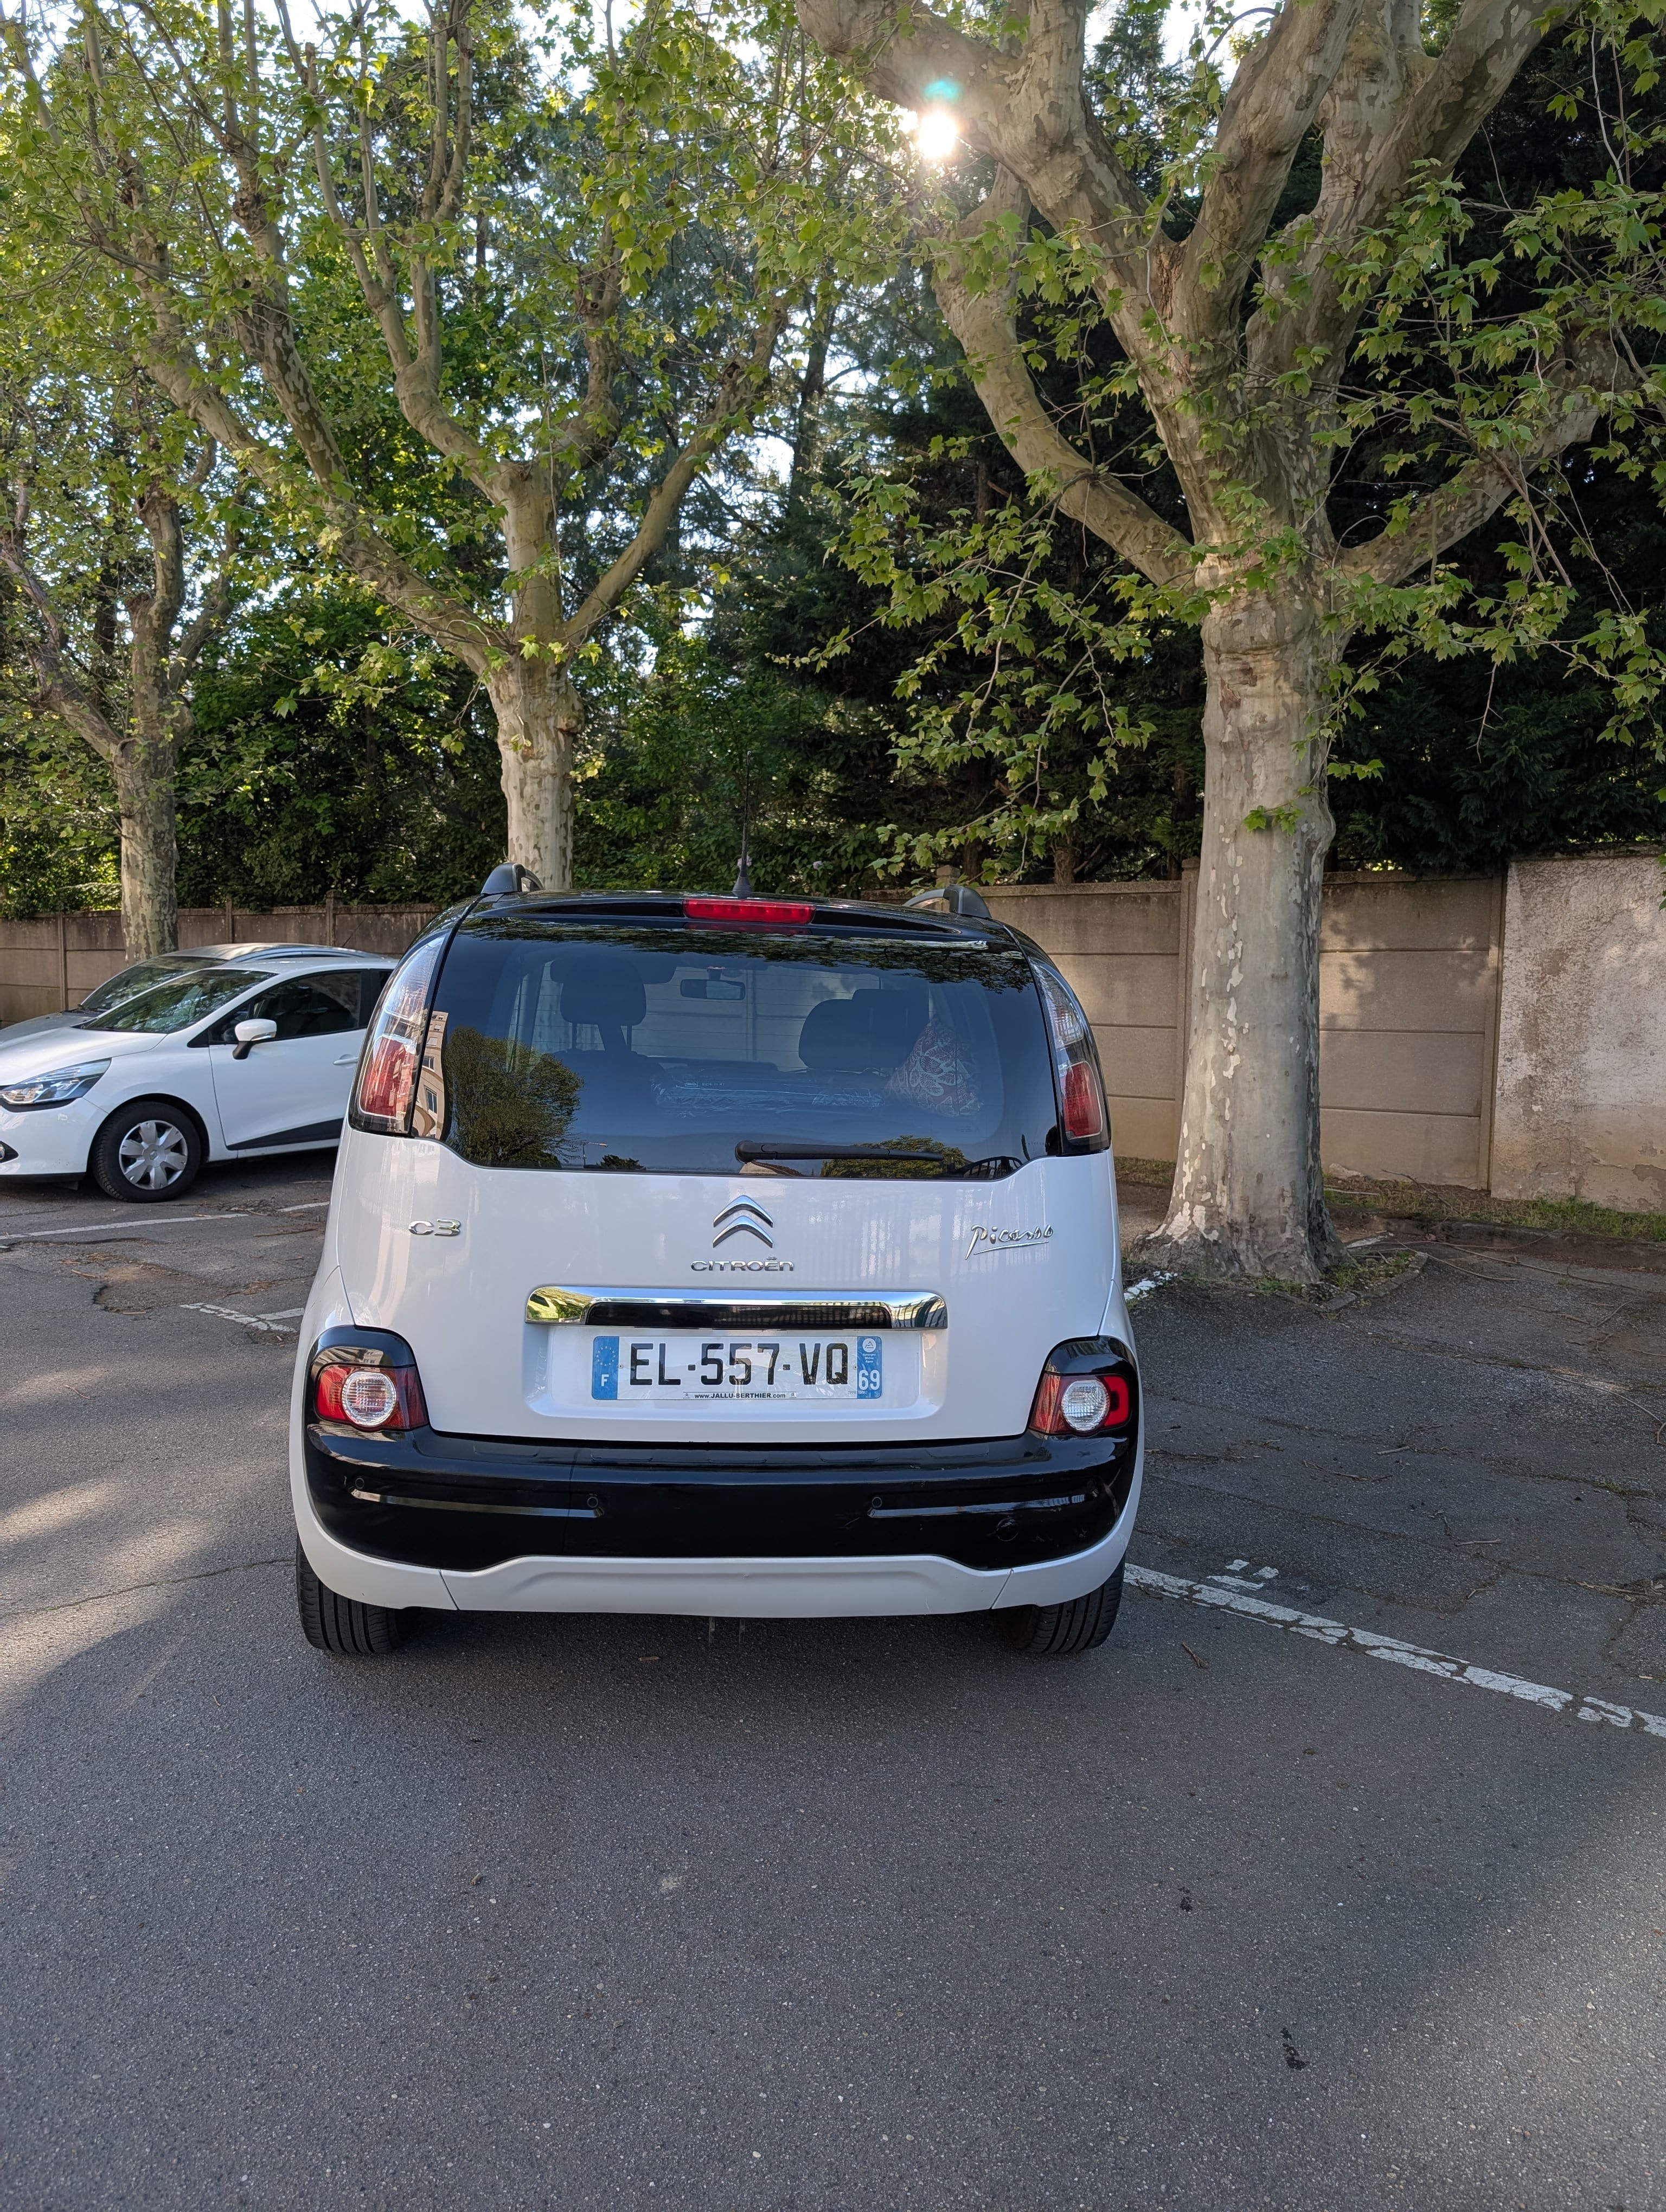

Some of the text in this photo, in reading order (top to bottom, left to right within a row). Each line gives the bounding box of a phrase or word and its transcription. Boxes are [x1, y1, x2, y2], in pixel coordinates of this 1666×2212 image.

[408, 1218, 461, 1237] C3
[964, 1224, 1054, 1259] Picasso
[690, 1256, 794, 1272] CITROËN
[629, 1342, 848, 1386] EL-557-VQ
[601, 1374, 610, 1387] F
[858, 1369, 880, 1390] 69
